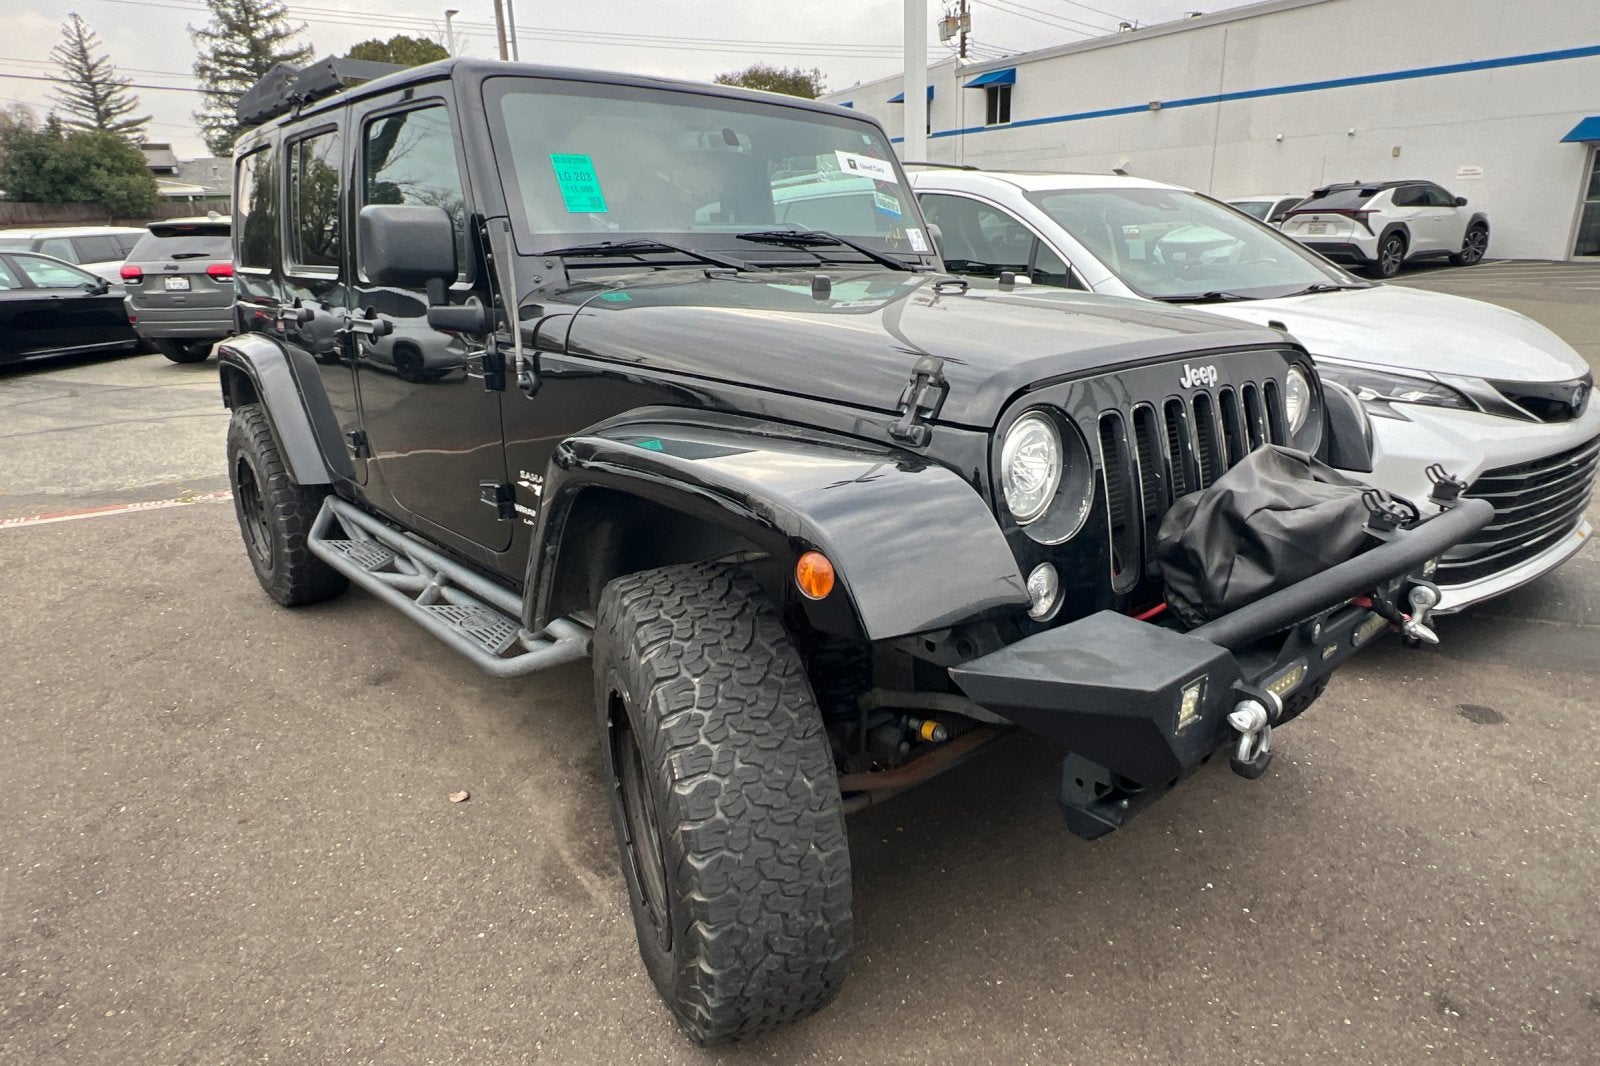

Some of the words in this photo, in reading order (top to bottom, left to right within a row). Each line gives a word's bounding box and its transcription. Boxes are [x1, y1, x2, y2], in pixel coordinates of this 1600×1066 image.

[559, 171, 571, 181] LG
[574, 171, 592, 181] 203
[1180, 364, 1218, 388] Jeep
